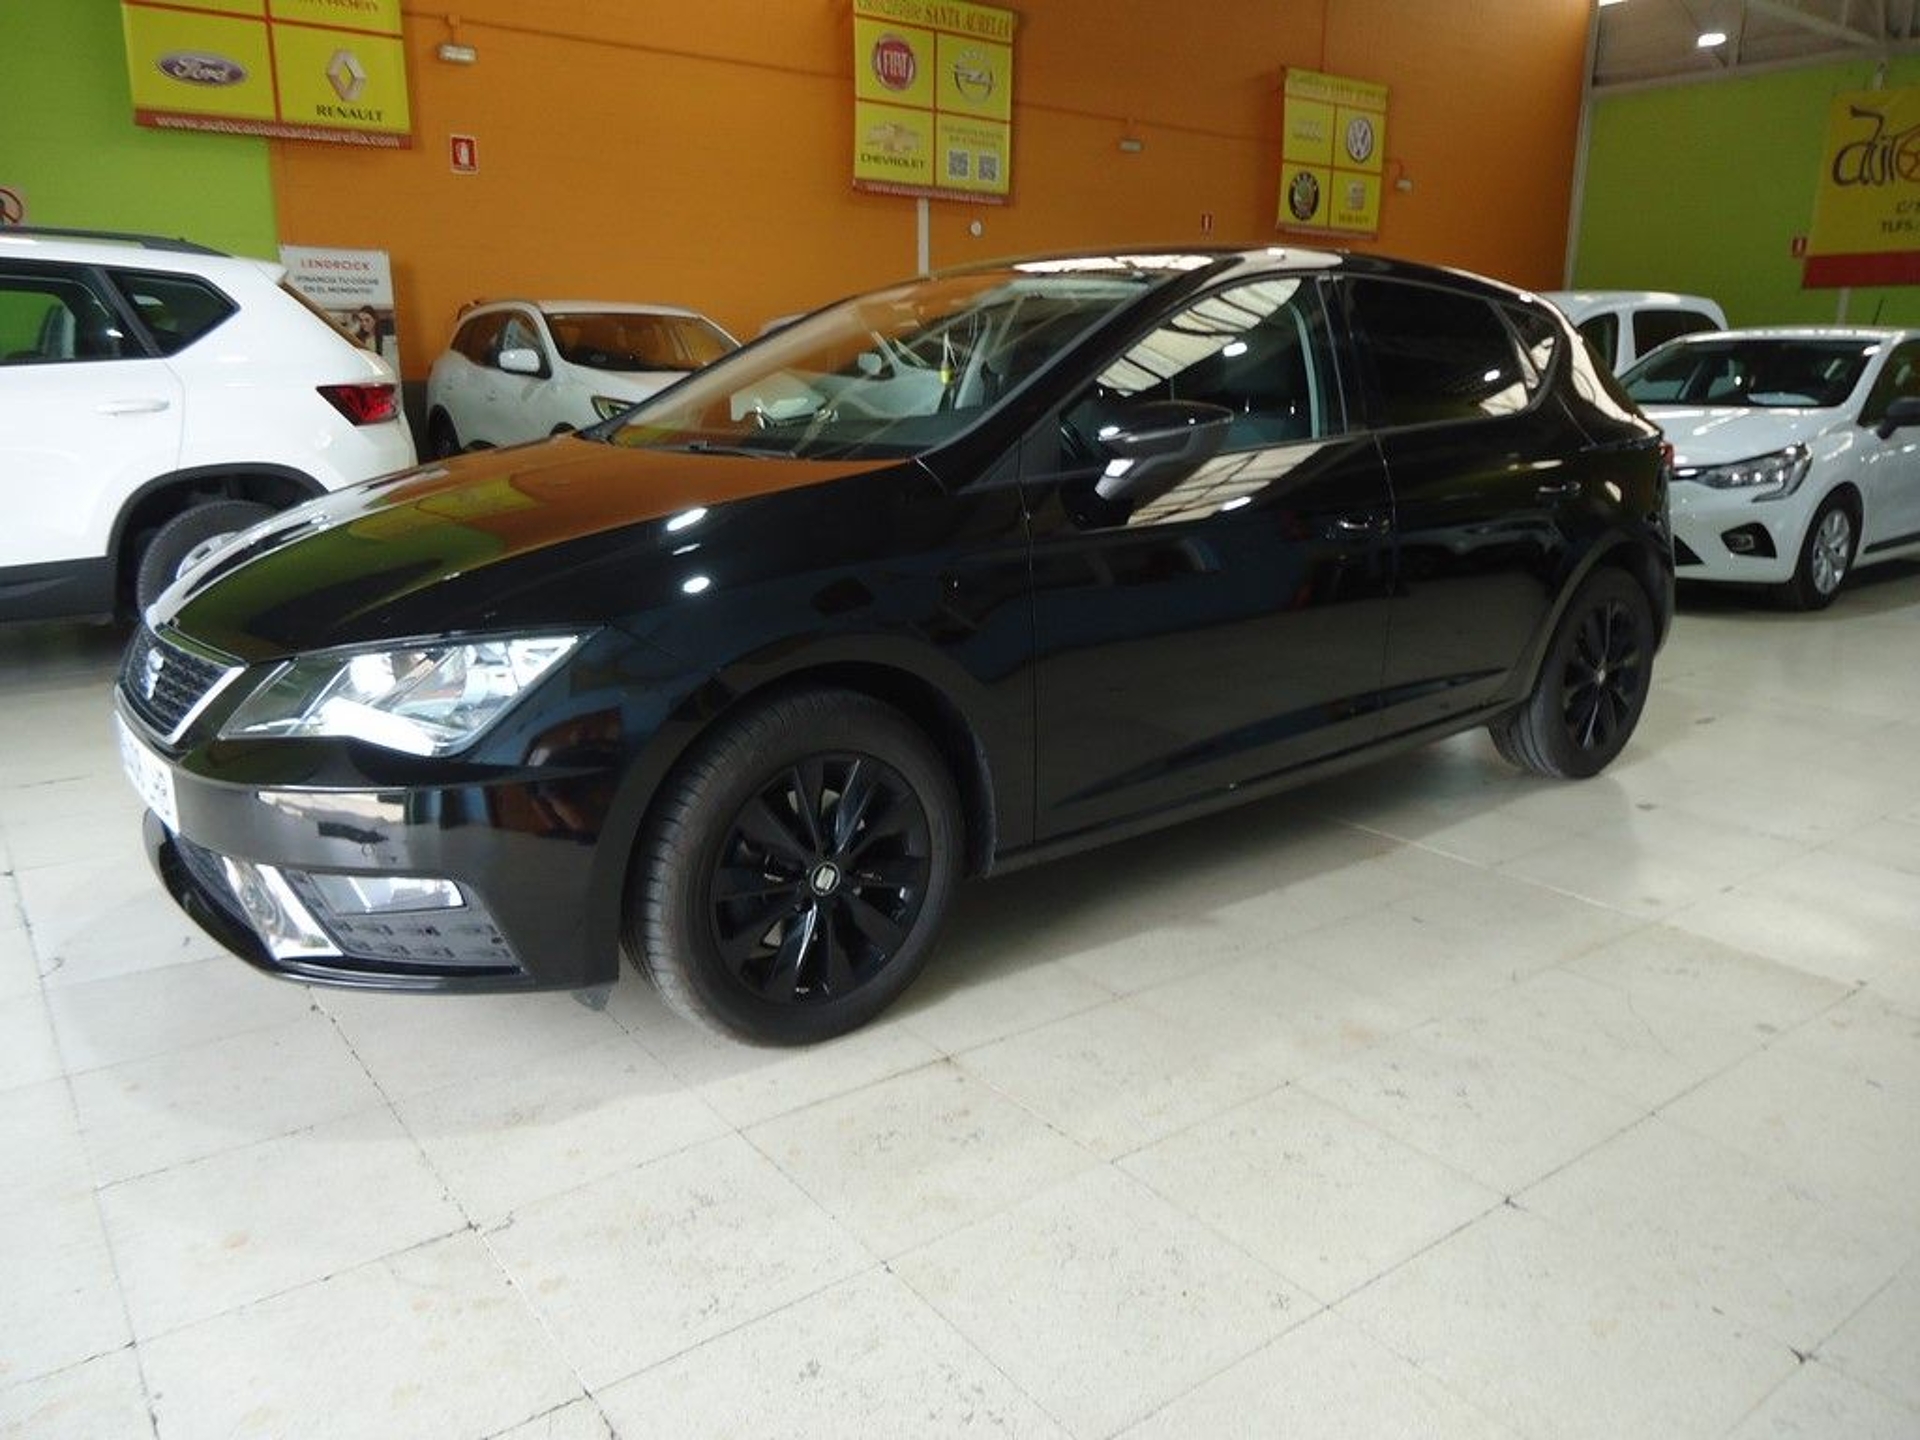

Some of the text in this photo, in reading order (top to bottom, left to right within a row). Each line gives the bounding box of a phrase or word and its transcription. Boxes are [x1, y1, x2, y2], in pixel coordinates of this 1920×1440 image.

[172, 57, 228, 84] Ford
[882, 49, 909, 78] FIAT
[316, 103, 384, 123] RENAULT
[859, 152, 926, 170] CHEVROLET
[300, 258, 371, 271] LENDROCK
